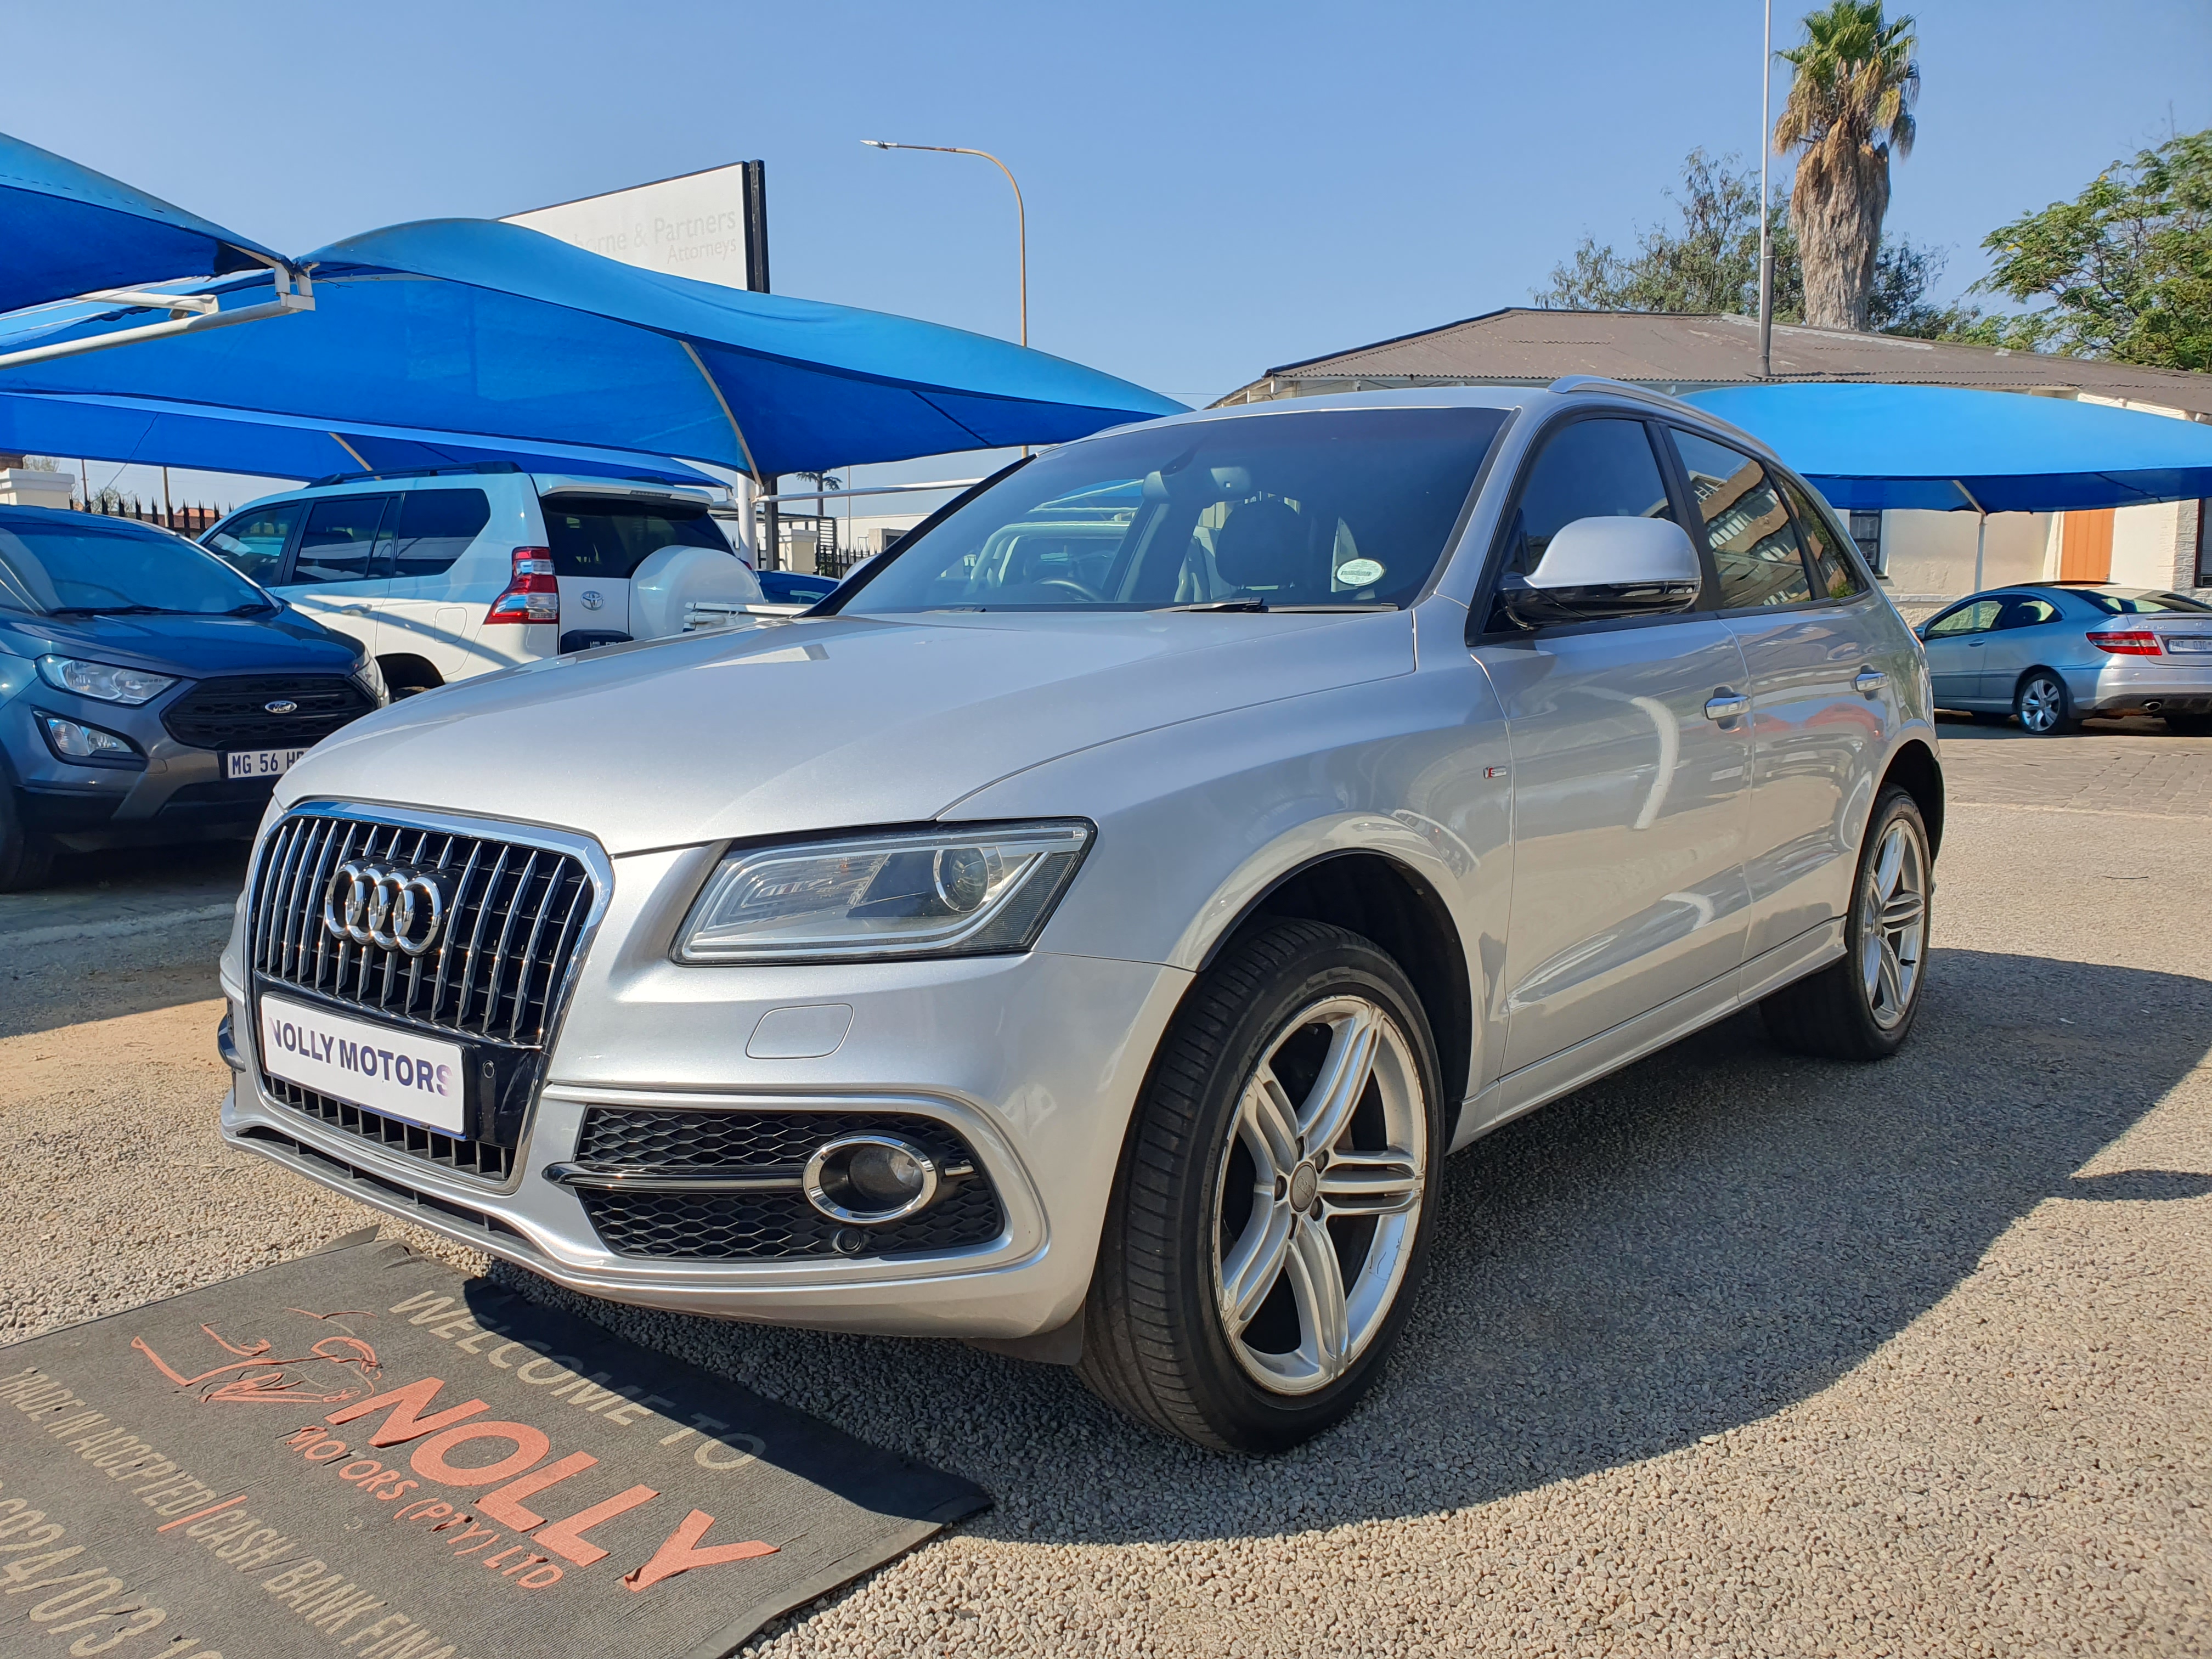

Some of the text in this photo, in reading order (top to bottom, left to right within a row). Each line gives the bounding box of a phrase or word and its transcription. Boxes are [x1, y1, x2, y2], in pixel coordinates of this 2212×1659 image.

[634, 222, 648, 248] &
[654, 211, 736, 244] Partners
[667, 238, 737, 264] Attorneys
[232, 754, 252, 775] MG
[259, 753, 279, 773] 56
[269, 1017, 453, 1097] NOLLY MOTORS
[388, 1289, 766, 1471] WELCOME TO
[43, 1409, 111, 1438] IN
[324, 1375, 781, 1593] NOLLY
